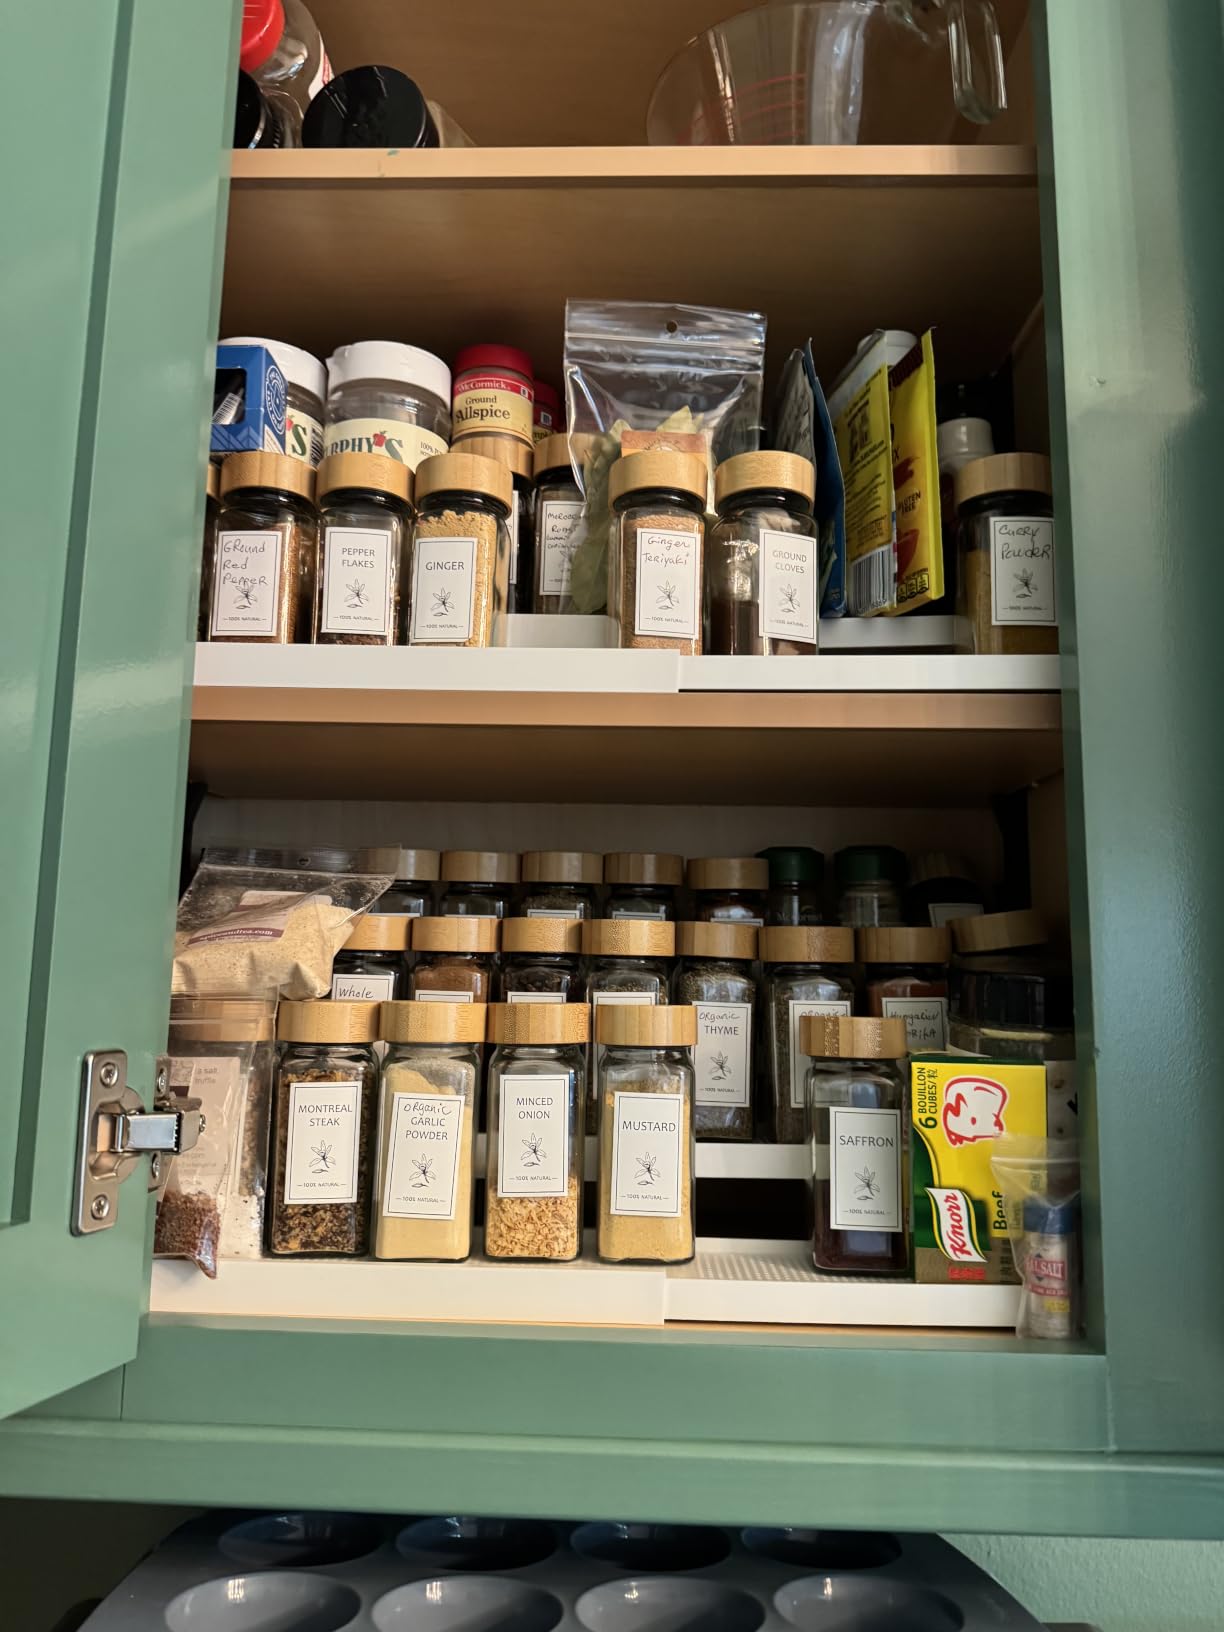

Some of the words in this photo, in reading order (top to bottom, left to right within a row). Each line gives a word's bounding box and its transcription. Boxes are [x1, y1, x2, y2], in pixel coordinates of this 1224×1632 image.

[459, 381, 507, 393] McCormick
[465, 396, 497, 405] Ground
[456, 405, 511, 424] Allspice
[341, 547, 375, 557] PEPPER
[772, 550, 807, 563] GROUND
[341, 559, 375, 568] FLAKES
[425, 561, 465, 571] GINGER
[775, 562, 805, 573] CLOVES
[338, 986, 374, 1000] Whole
[704, 1025, 740, 1036] THYME
[917, 1067, 927, 1114] BOUILLON
[516, 1097, 553, 1106] MINCED
[298, 1104, 353, 1113] MONTREAL
[518, 1110, 551, 1119] ONION
[309, 1117, 340, 1127] STEAK
[410, 1116, 446, 1127] GARLIC
[622, 1120, 676, 1132] MUSTARD
[918, 1116, 938, 1129] 6
[405, 1130, 448, 1141] POWDER
[839, 1135, 894, 1148] SAFFRON
[943, 1192, 973, 1260] Knorr
